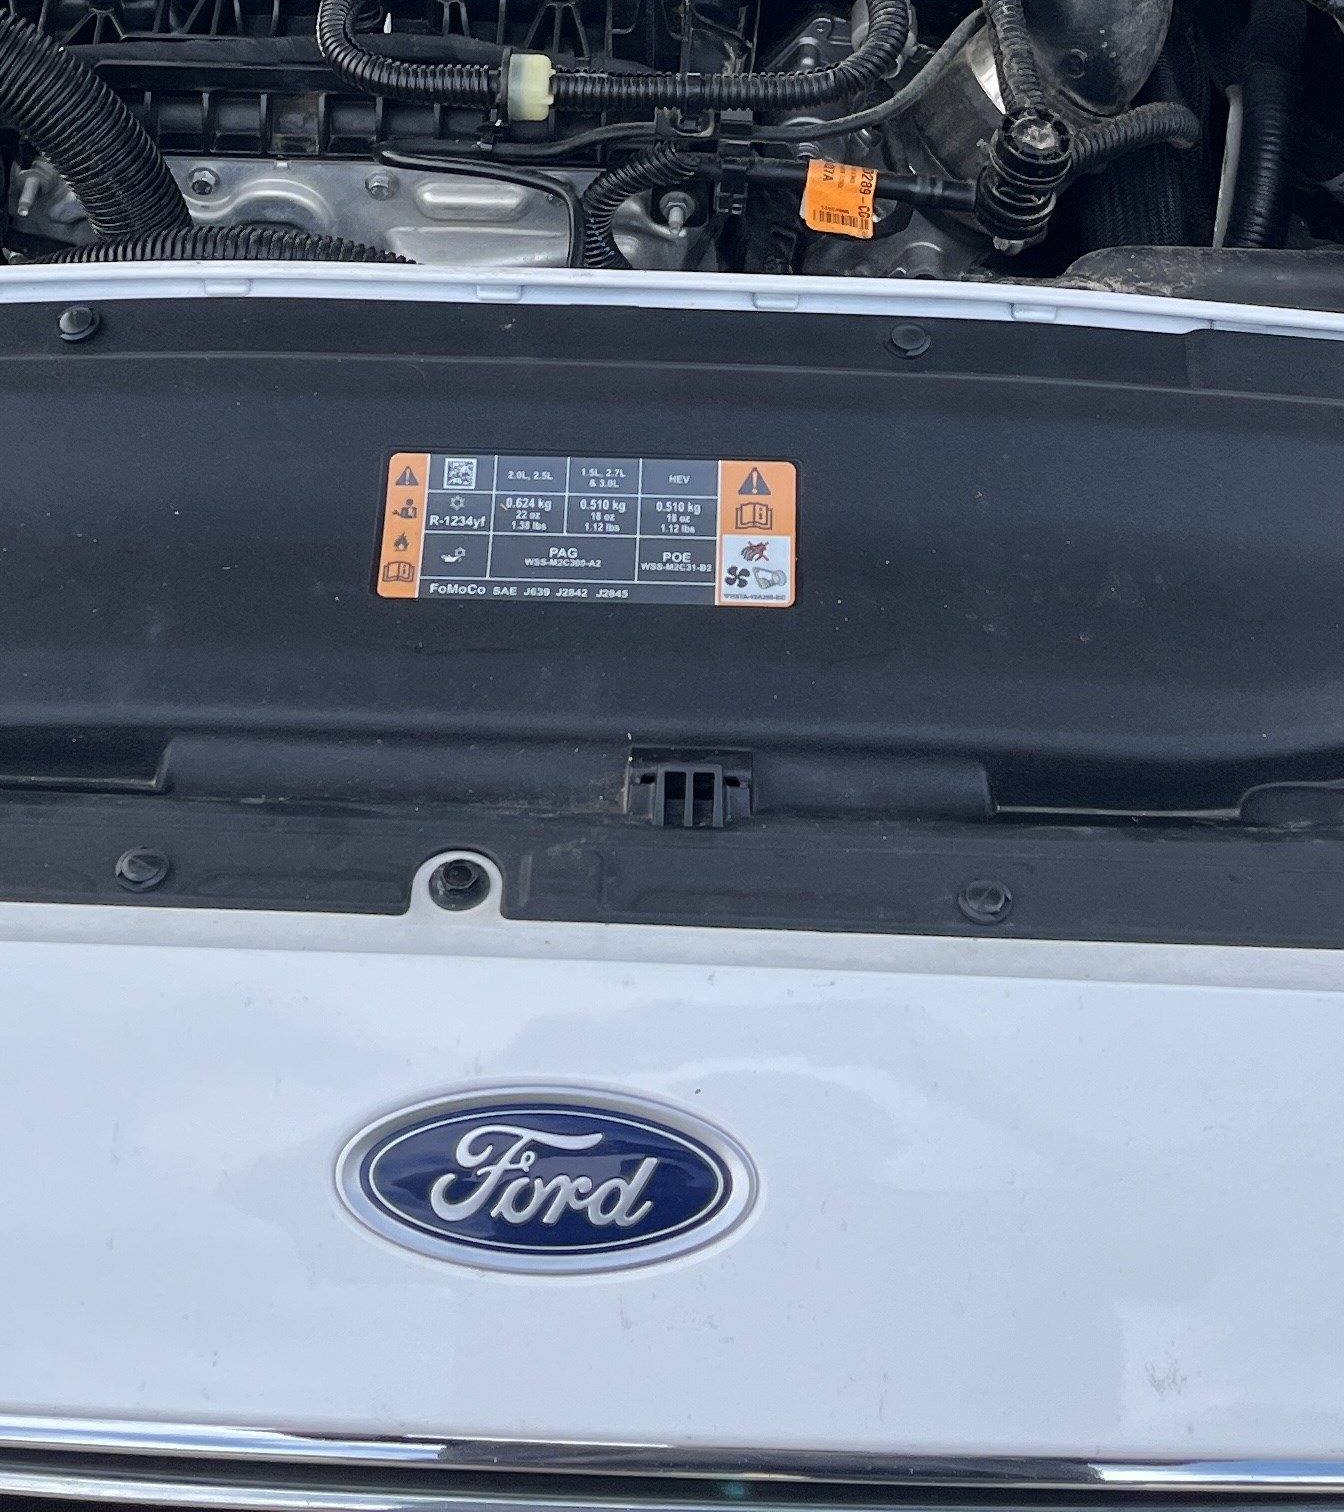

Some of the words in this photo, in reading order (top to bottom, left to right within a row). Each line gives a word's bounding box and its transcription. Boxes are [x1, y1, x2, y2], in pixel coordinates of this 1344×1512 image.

[508, 470, 531, 480] 2.0L,
[533, 470, 553, 480] 2.5L
[605, 468, 626, 478] 2.7L
[599, 479, 620, 488] 3.0L
[668, 474, 691, 484] HEV
[506, 497, 535, 509] 0.624
[537, 497, 552, 512] kg
[579, 499, 610, 510] 0.510
[612, 499, 627, 513] kg
[655, 501, 685, 512] 0.510
[687, 502, 702, 515] kg
[515, 510, 528, 519] 22
[529, 511, 541, 519] oz
[603, 513, 615, 521] oz
[679, 515, 691, 523] oz
[429, 514, 486, 529] R-1234yf
[532, 521, 547, 530] lbs
[584, 522, 604, 532] 1.12
[605, 522, 621, 532] lbs
[660, 524, 680, 533] 1.12
[680, 524, 695, 533] lbs
[549, 547, 579, 558] PAG
[662, 551, 692, 563] POE
[429, 582, 486, 595] FoMoCo
[492, 586, 518, 596] SAE
[523, 587, 551, 597] J639
[430, 1123, 659, 1228] Ford
